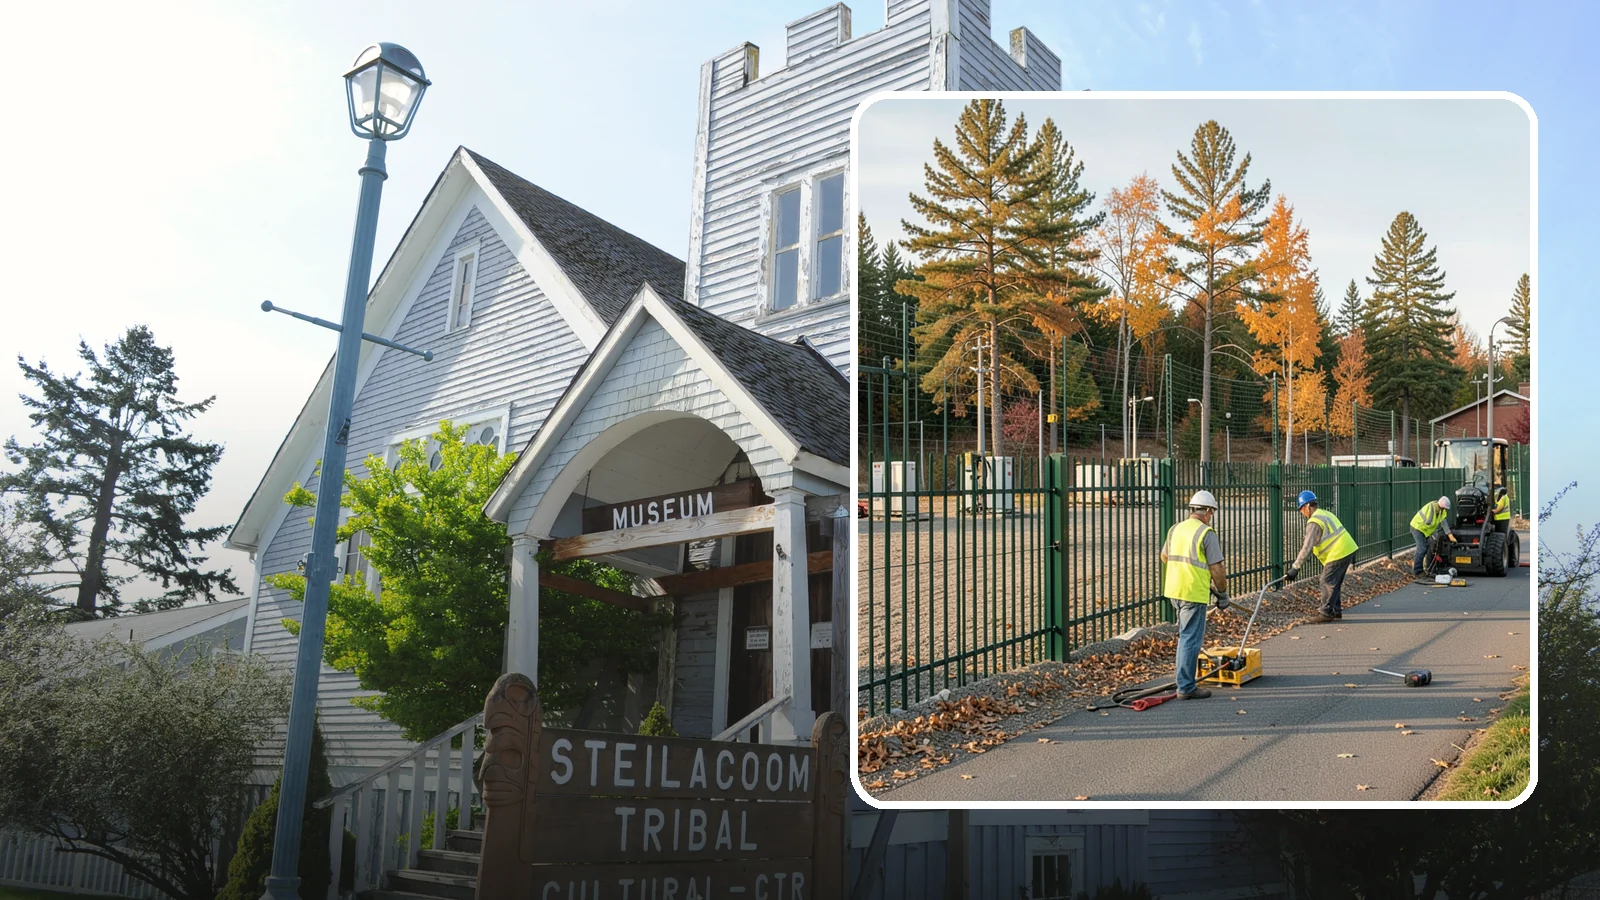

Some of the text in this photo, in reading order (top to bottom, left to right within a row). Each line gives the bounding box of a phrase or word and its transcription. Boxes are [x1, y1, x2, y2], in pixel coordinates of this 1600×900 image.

[612, 491, 714, 531] MUSEUM
[551, 738, 809, 792] STEILACOOM
[615, 807, 757, 851] TRIBAL
